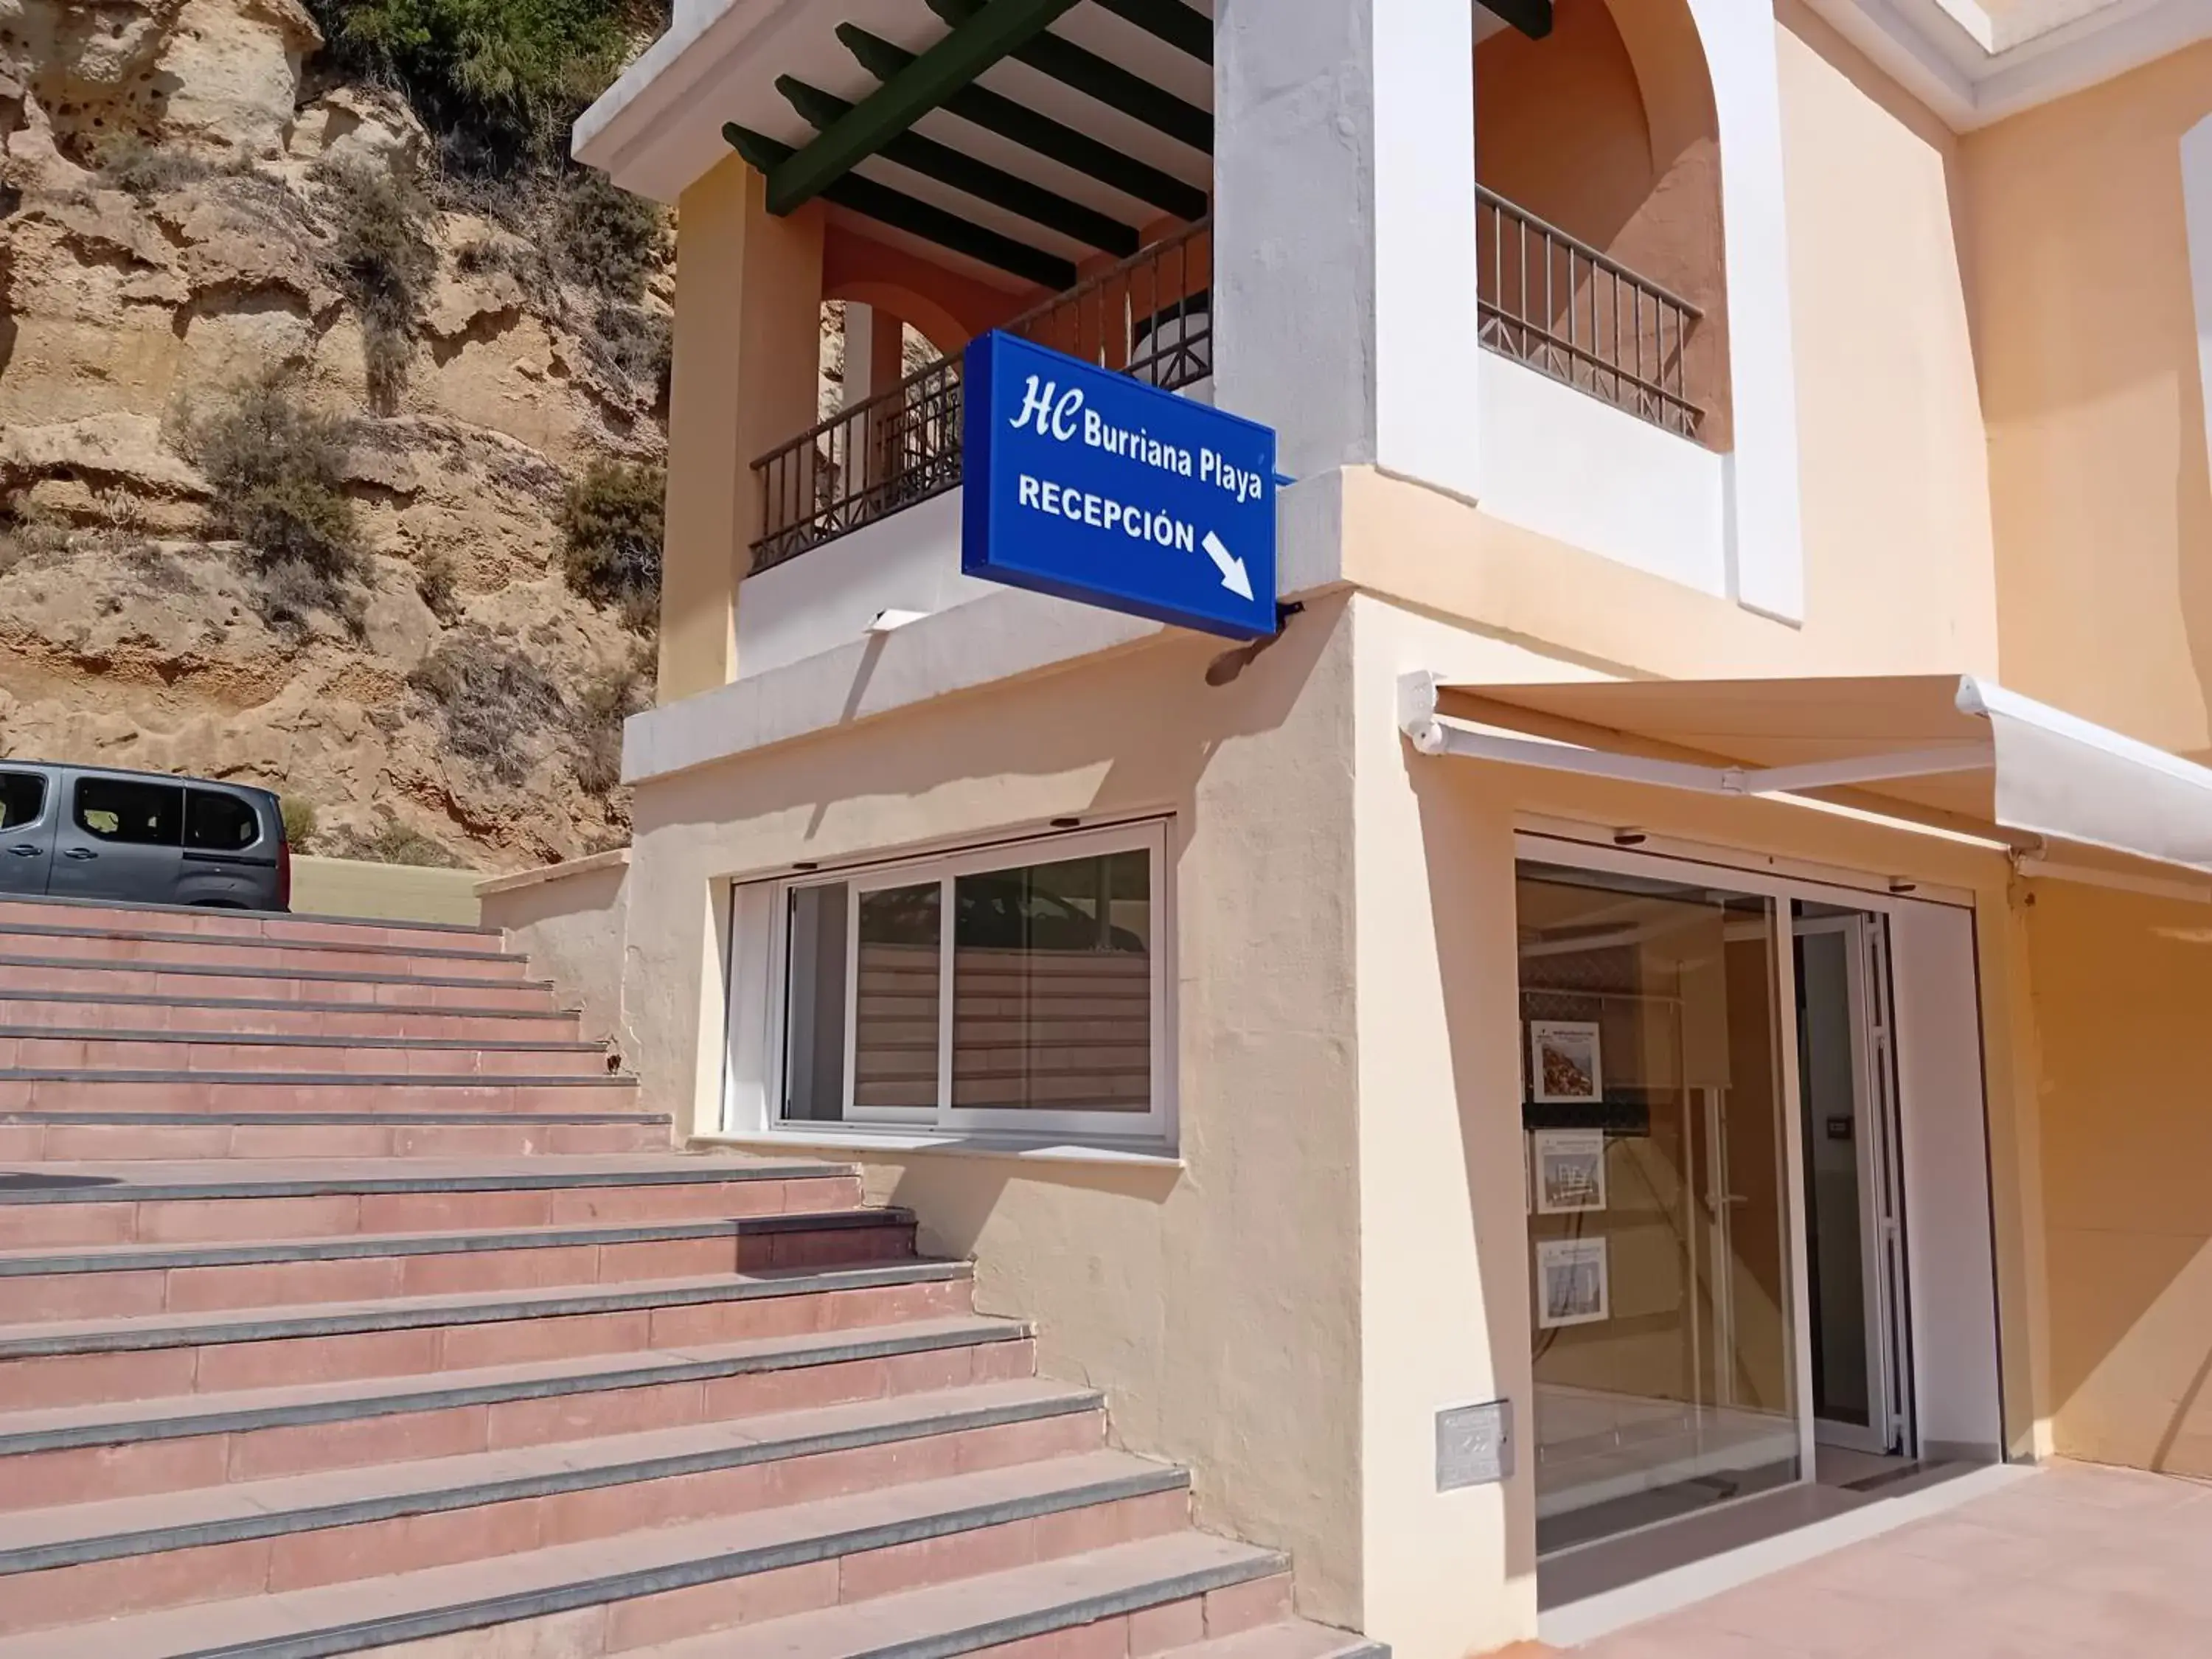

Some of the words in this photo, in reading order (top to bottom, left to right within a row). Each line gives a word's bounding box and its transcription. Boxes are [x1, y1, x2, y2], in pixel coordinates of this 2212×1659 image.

[1009, 375, 1085, 441] HC
[1084, 408, 1192, 478] Burriana
[1200, 448, 1262, 503] Playa
[1018, 473, 1194, 553] RECEPCIÓN
